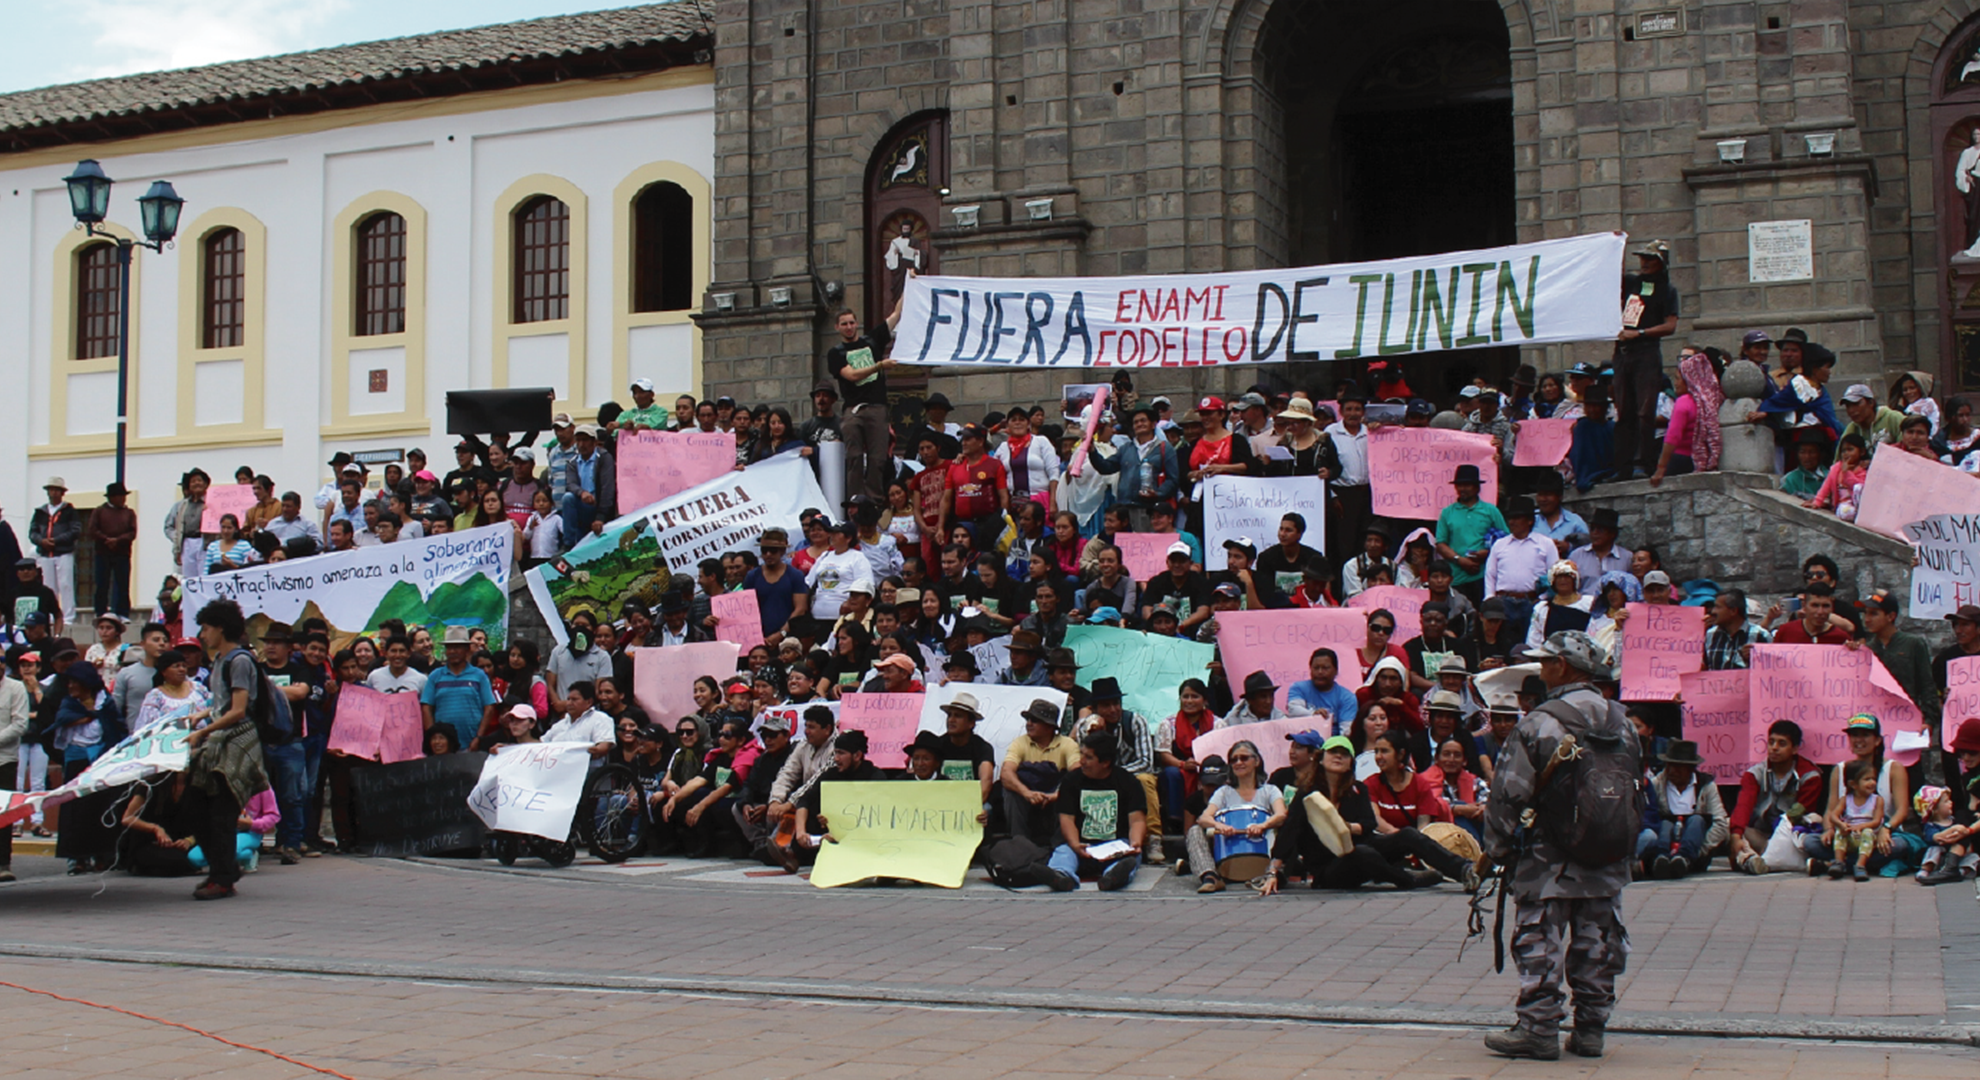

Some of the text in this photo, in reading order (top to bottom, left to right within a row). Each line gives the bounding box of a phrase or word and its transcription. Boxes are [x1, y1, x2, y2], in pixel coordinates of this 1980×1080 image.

[1115, 285, 1231, 323] ENAMI
[1334, 255, 1541, 359] JUNIN
[917, 288, 1092, 365] FUERA
[1251, 277, 1329, 361] DE
[1093, 326, 1248, 367] CODELCO
[652, 485, 752, 532] ¡FUERA
[1213, 483, 1252, 510] Están
[662, 503, 768, 551] CORNERSTONE
[669, 551, 692, 570] DE
[1918, 545, 1976, 578] NUNCA
[214, 570, 314, 595] extractivismo
[322, 565, 382, 584] amenaza
[390, 563, 399, 574] a
[402, 555, 415, 573] la
[1917, 582, 1943, 606] UNA
[1647, 605, 1682, 632] País
[1244, 625, 1266, 647] EL
[1273, 622, 1366, 646] CERCADO
[1752, 646, 1808, 671] Minería
[1696, 677, 1746, 694] INTAG
[1759, 676, 1815, 700] Minería
[1682, 705, 1749, 728] MEGADIVERS
[1878, 702, 1914, 722] vidas
[1707, 734, 1735, 755] NO
[838, 803, 974, 835] SAN MARTIN
